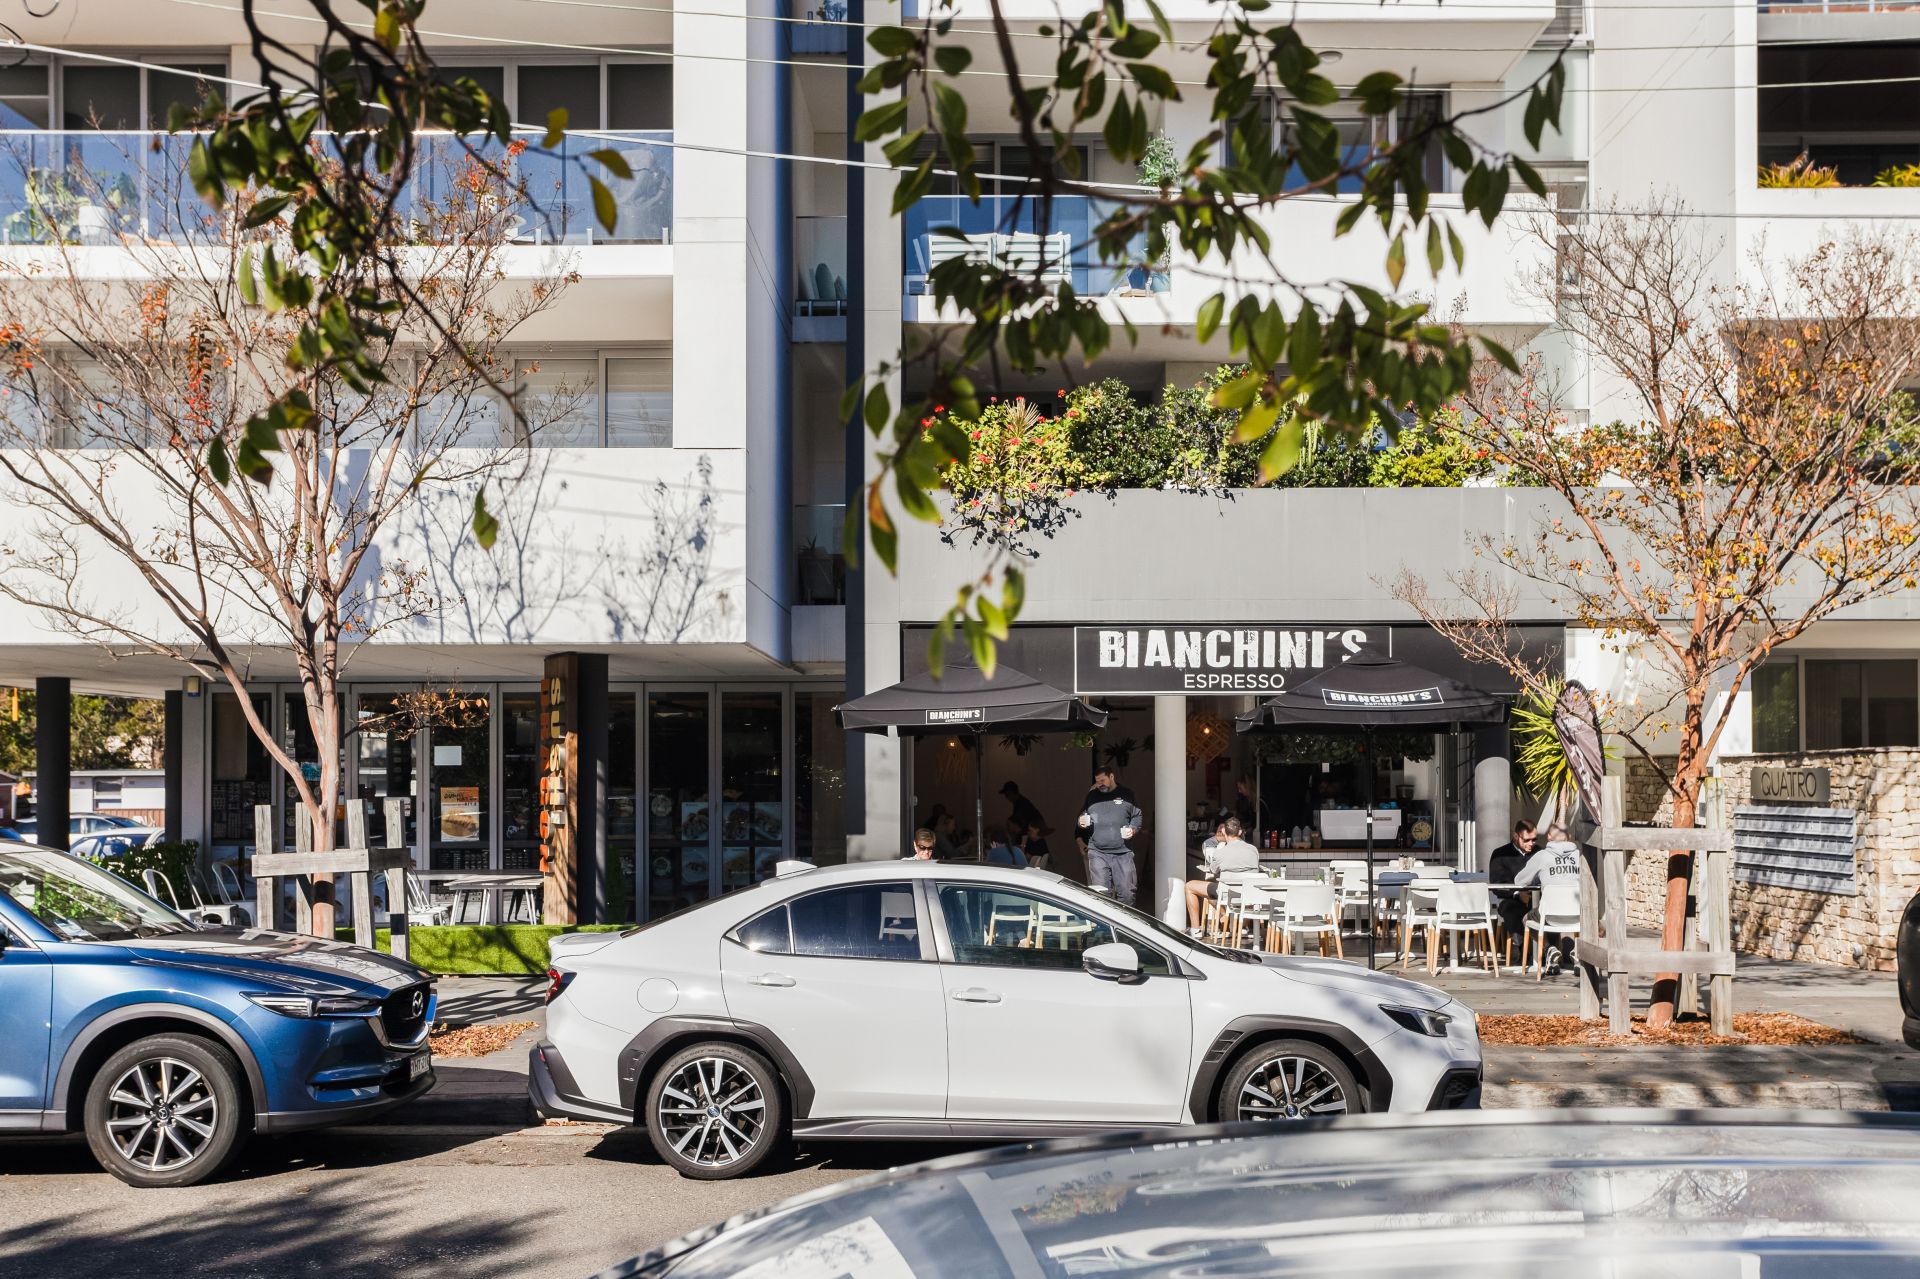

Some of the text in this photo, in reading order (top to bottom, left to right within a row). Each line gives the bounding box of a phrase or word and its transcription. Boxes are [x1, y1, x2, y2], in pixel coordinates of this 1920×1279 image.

[1184, 673, 1285, 689] ESPRESSO
[1330, 691, 1432, 703] BIANCHINI'S
[929, 709, 980, 720] BIANCHINI'S
[549, 677, 563, 825] SUSHI
[1761, 771, 1817, 798] QUATTRO
